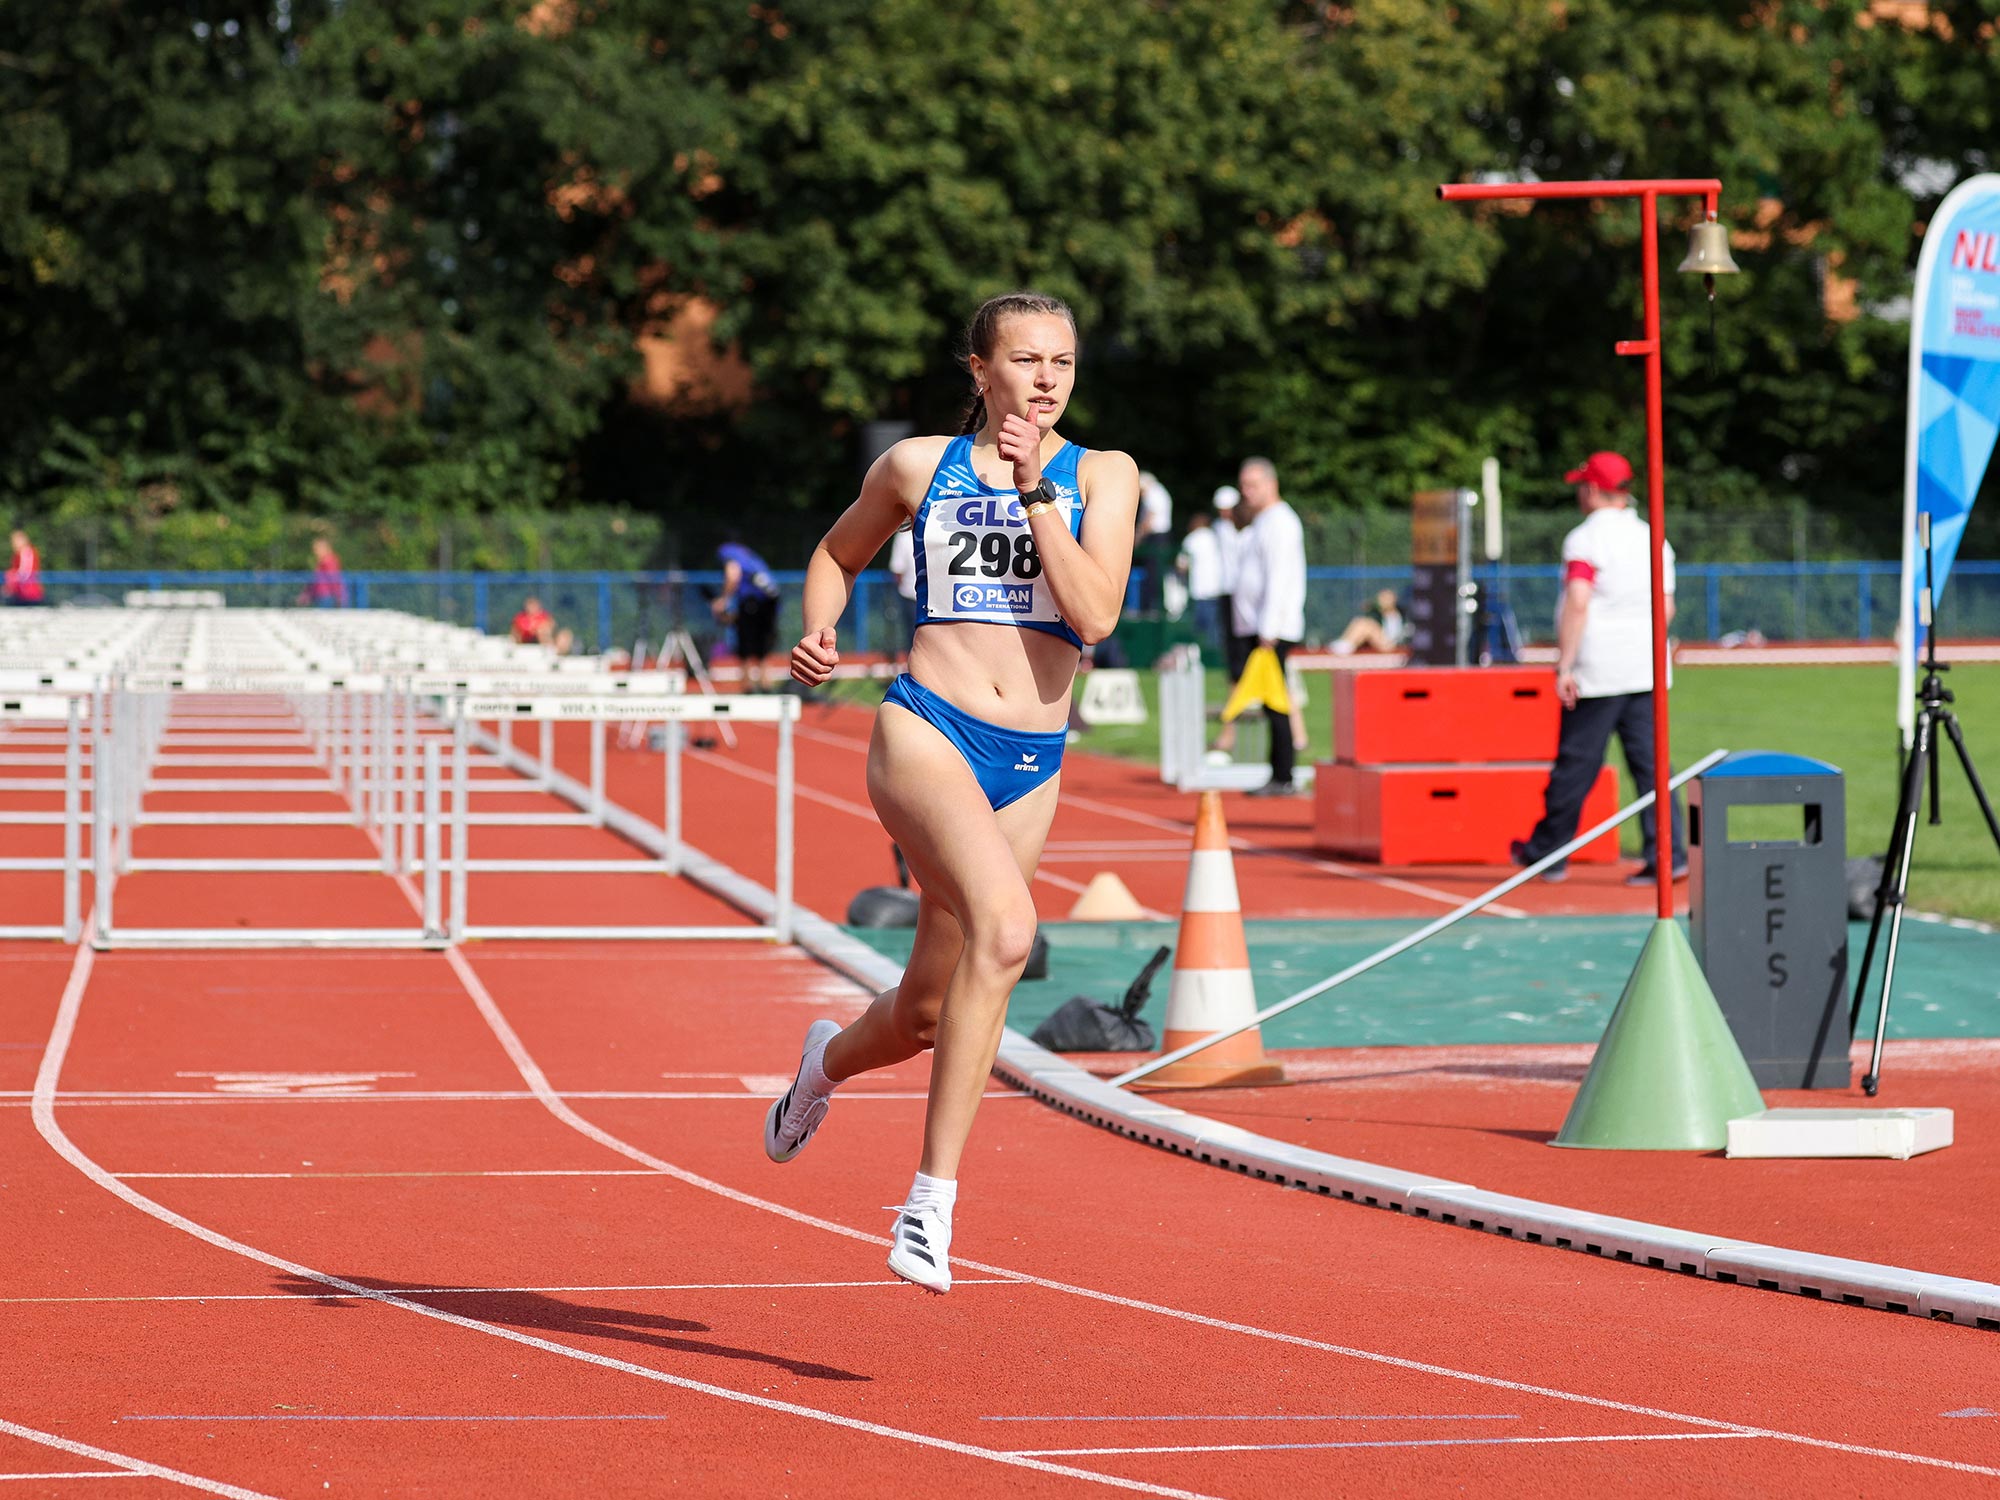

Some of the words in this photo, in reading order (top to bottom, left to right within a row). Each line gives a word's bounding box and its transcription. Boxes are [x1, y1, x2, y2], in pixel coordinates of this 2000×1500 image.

[956, 500, 1029, 527] GLS
[948, 531, 1042, 579] 298
[986, 589, 1030, 603] PLAN
[1014, 763, 1039, 772] erima
